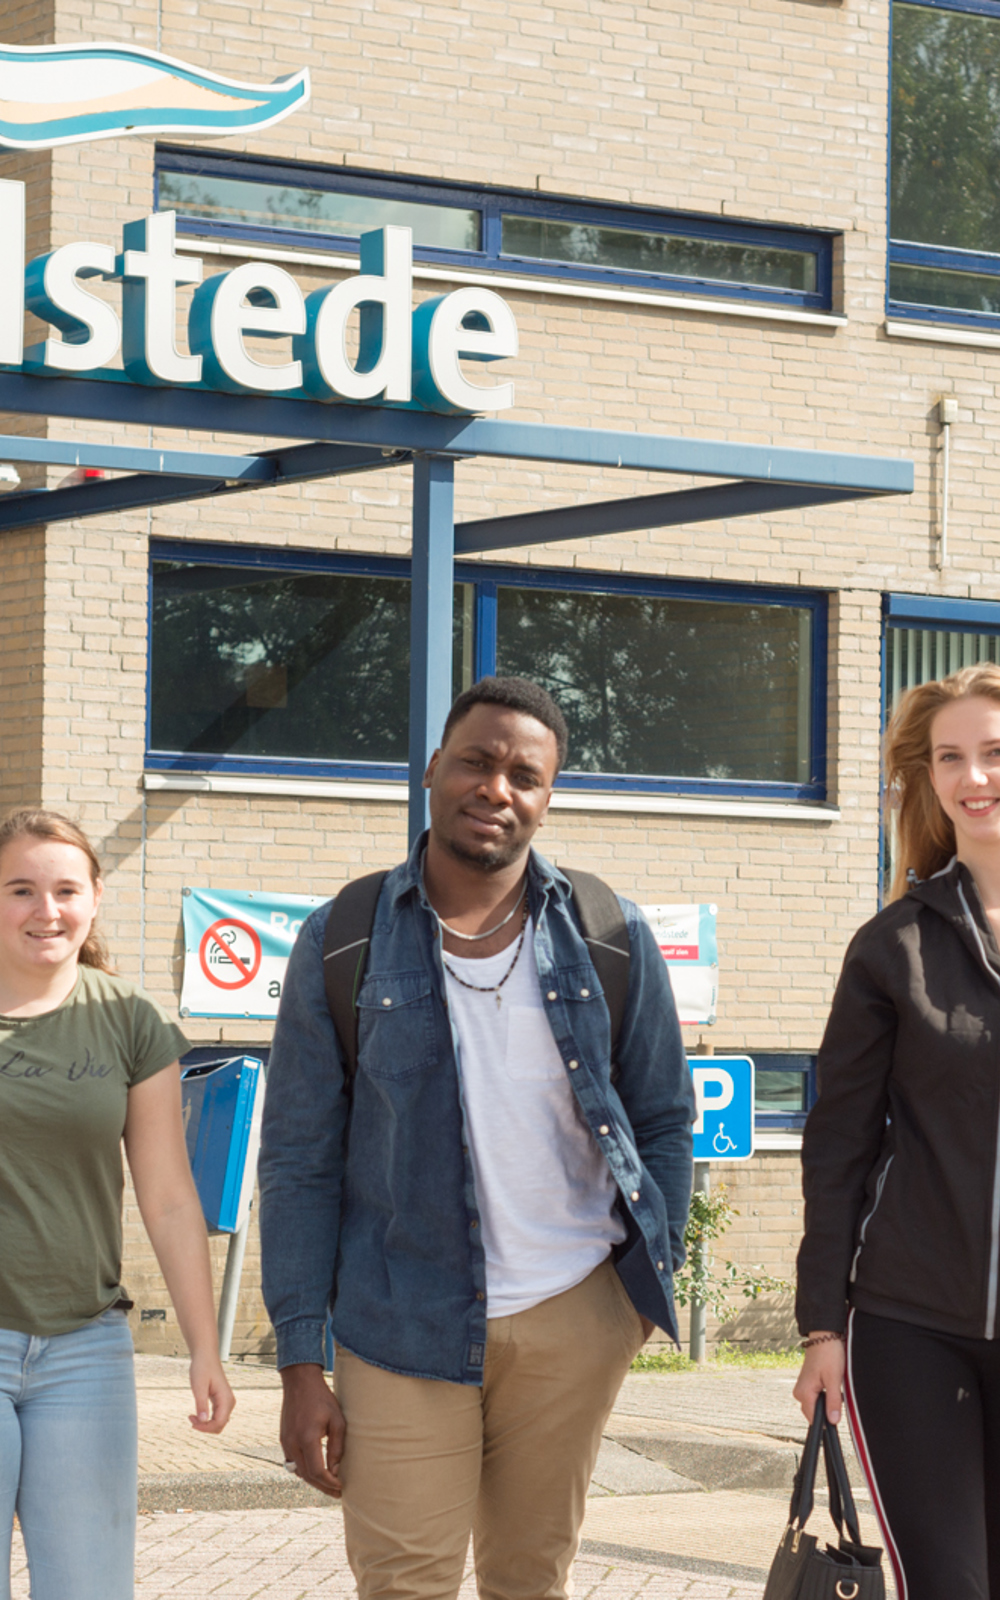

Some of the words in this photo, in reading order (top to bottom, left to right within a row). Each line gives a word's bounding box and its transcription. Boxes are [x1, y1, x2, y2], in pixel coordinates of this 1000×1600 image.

[0, 1050, 53, 1078] La
[67, 1047, 115, 1081] Vie
[692, 1068, 734, 1134] P
